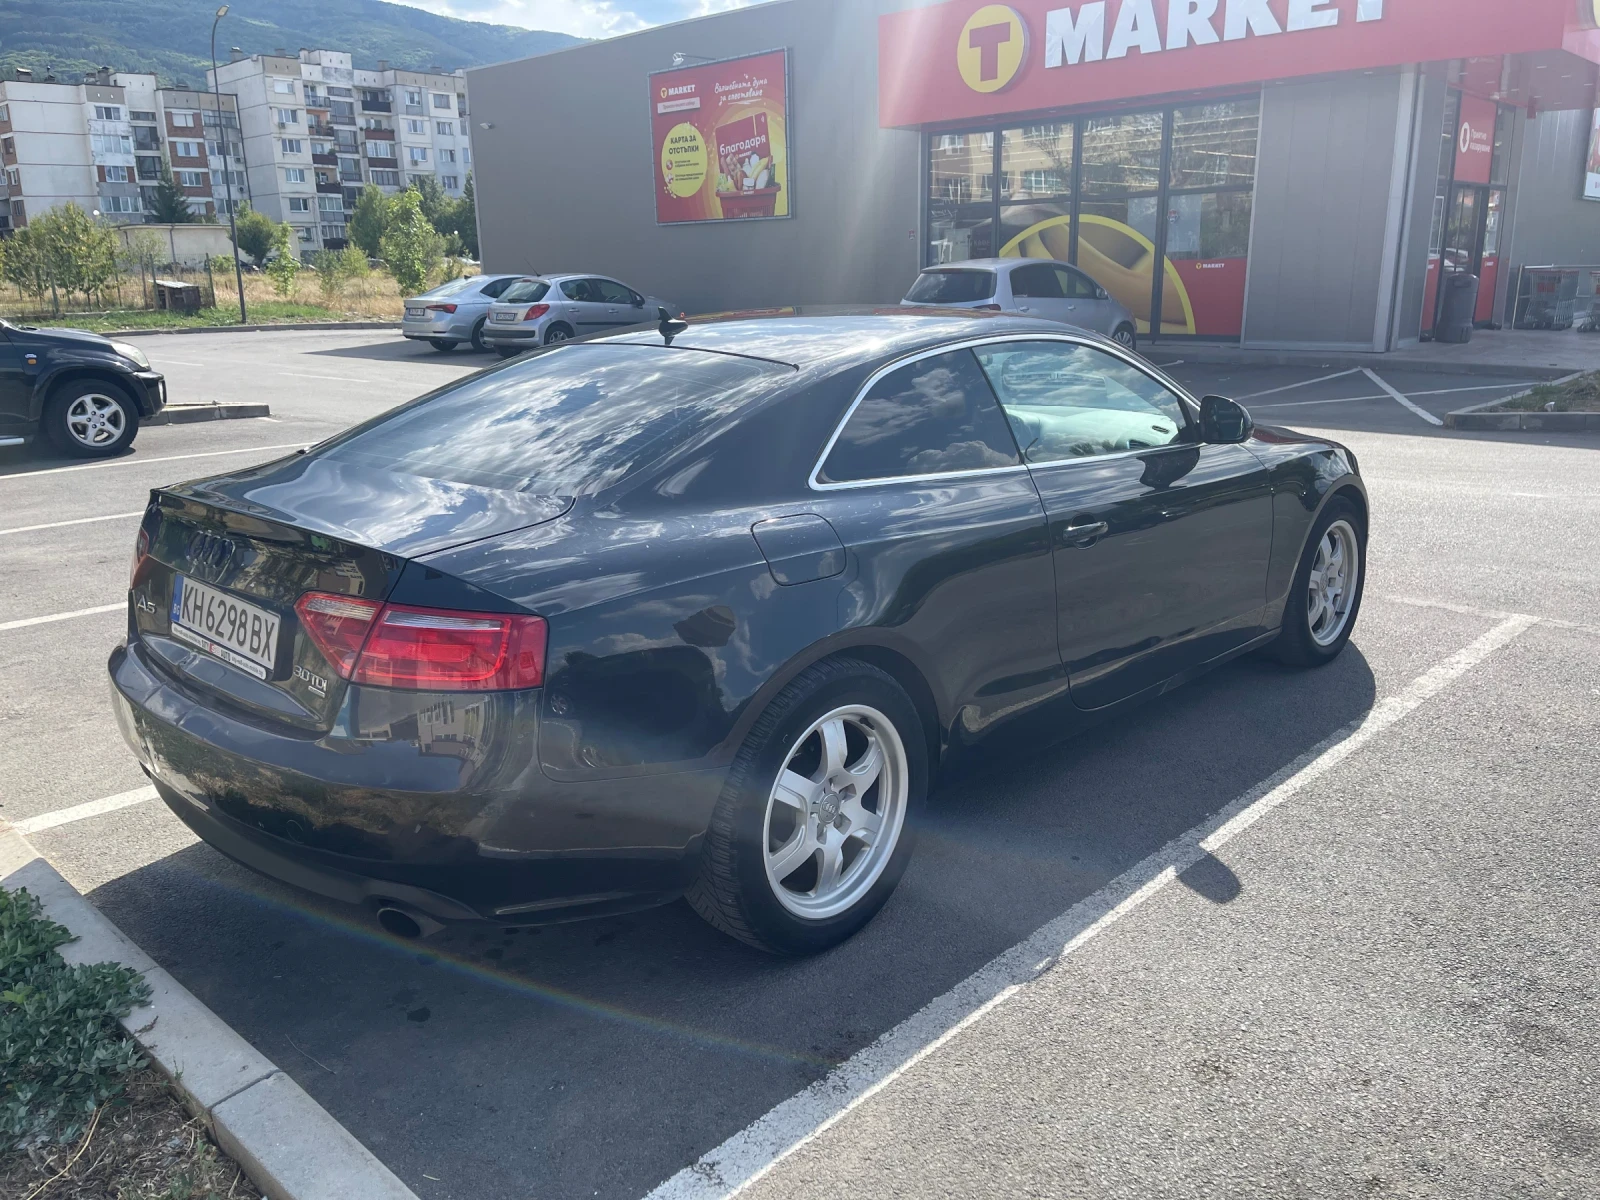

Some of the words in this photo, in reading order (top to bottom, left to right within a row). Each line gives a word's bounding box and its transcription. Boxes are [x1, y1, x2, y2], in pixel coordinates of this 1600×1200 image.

[969, 21, 1011, 82] T
[668, 84, 696, 96] MARKET
[670, 136, 688, 144] КАРТА
[719, 134, 766, 156] благодаря
[668, 145, 699, 155] ОТСТЪПКИ
[137, 594, 156, 615] A5
[173, 603, 180, 615] BG
